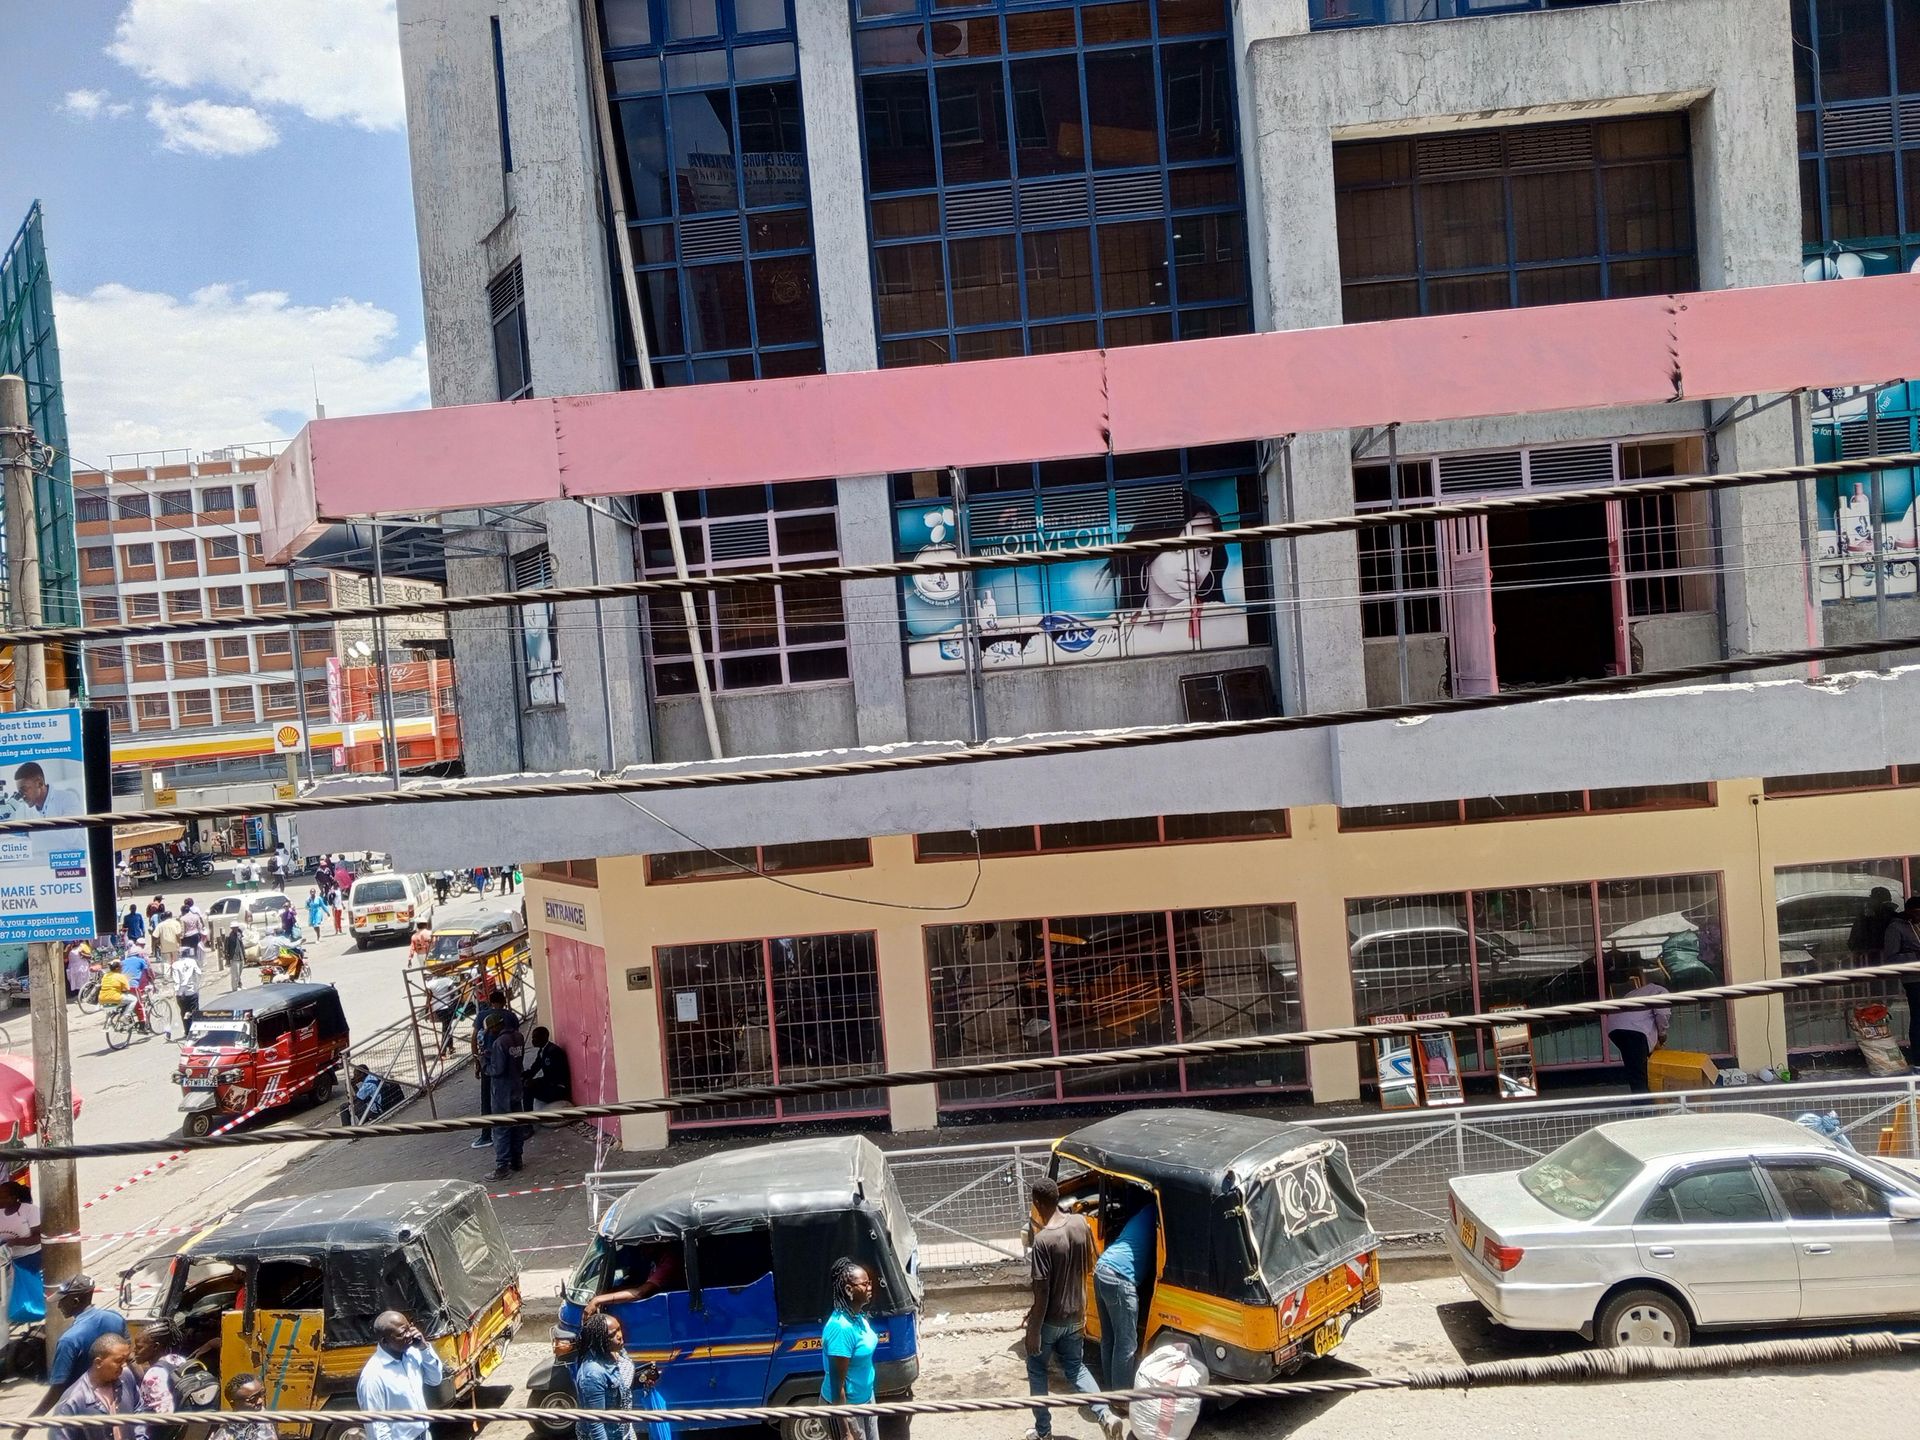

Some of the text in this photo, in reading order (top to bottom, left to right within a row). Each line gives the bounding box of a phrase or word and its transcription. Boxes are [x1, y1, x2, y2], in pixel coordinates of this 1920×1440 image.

[980, 545, 1001, 556] with
[1002, 530, 1067, 555] OLIVE
[0, 718, 58, 731] best time is
[0, 733, 45, 744] ght now.
[34, 745, 72, 754] treatment
[1, 843, 28, 852] Clinic
[0, 883, 83, 897] MARIE STOPES
[1, 898, 38, 910] KENYA
[545, 902, 584, 925] ENTRANCE
[6, 920, 26, 928] your
[26, 916, 79, 927] appointment
[11, 930, 27, 938] 109
[33, 928, 56, 937] 0800
[56, 927, 73, 936] 720
[74, 926, 91, 935] 005
[802, 1339, 822, 1349] 3 PA
